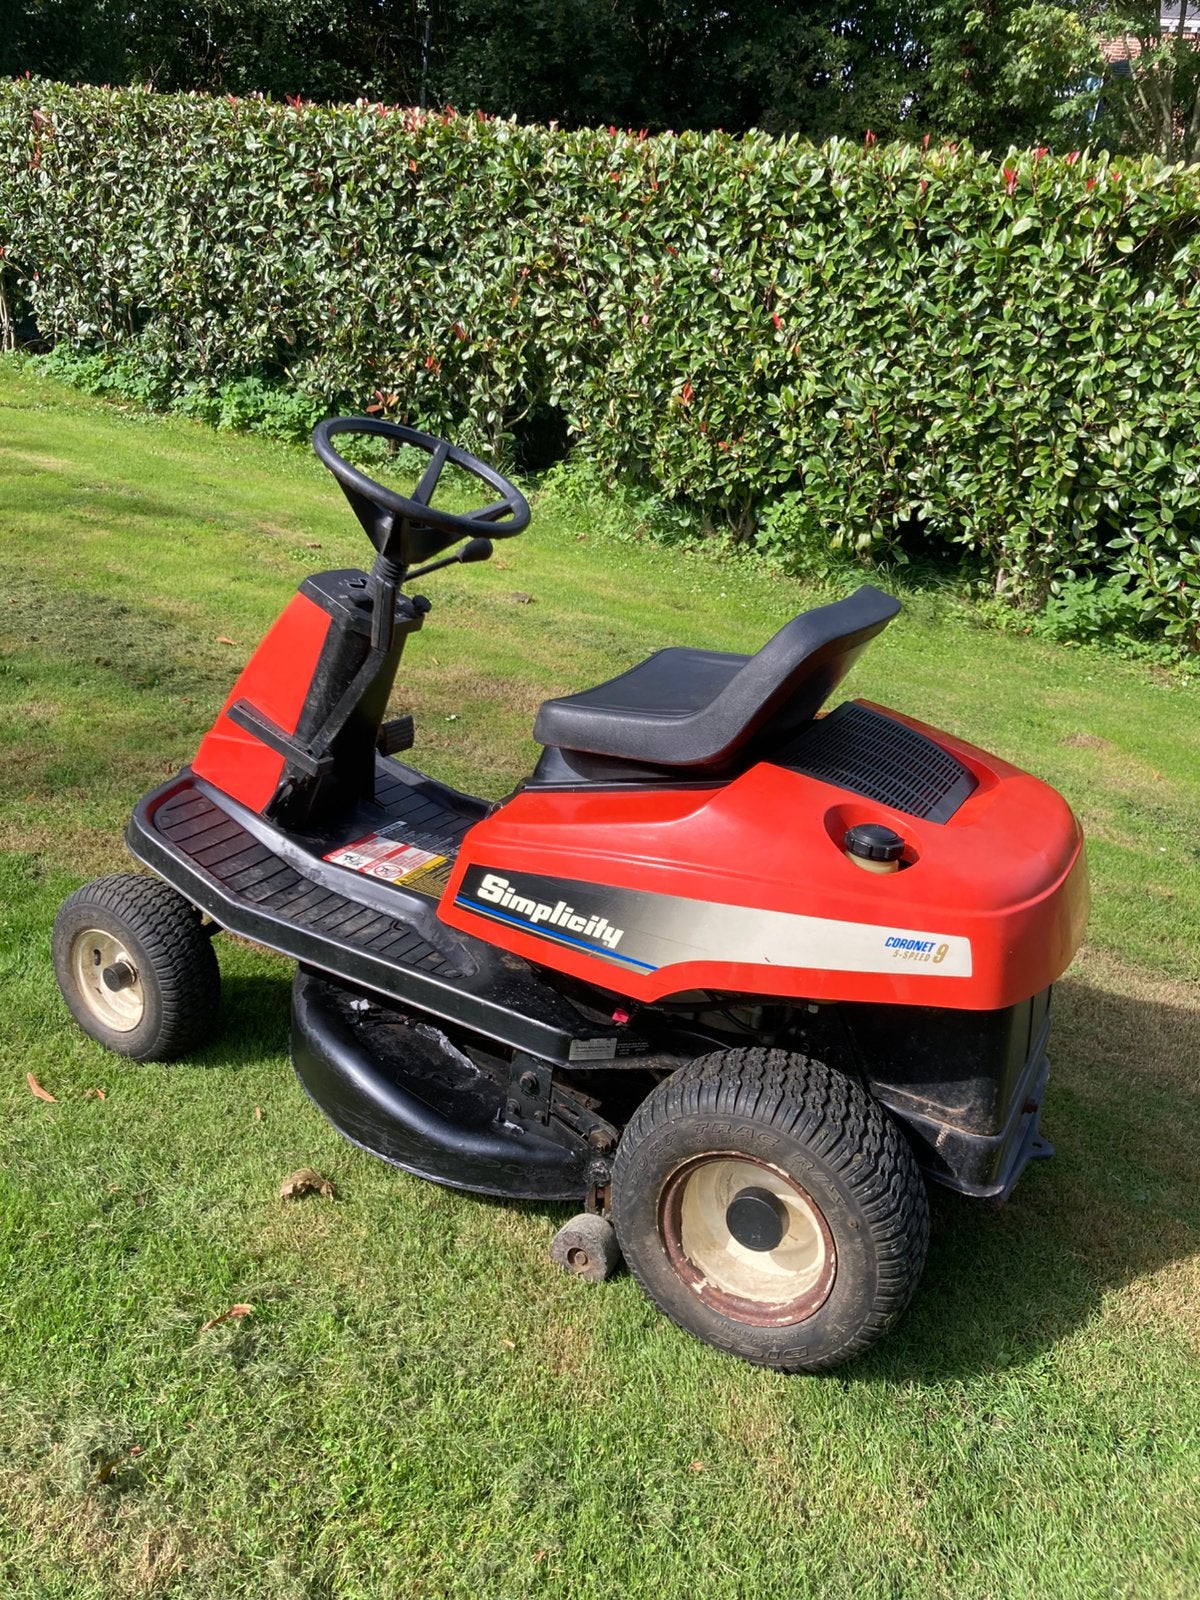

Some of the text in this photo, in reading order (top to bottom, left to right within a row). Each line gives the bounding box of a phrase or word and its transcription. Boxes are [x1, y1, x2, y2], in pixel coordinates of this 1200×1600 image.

[477, 873, 625, 949] Simplicity
[884, 936, 950, 964] CORONET 9
[892, 949, 931, 962] 5-SPEED
[693, 1121, 781, 1148] TRAC
